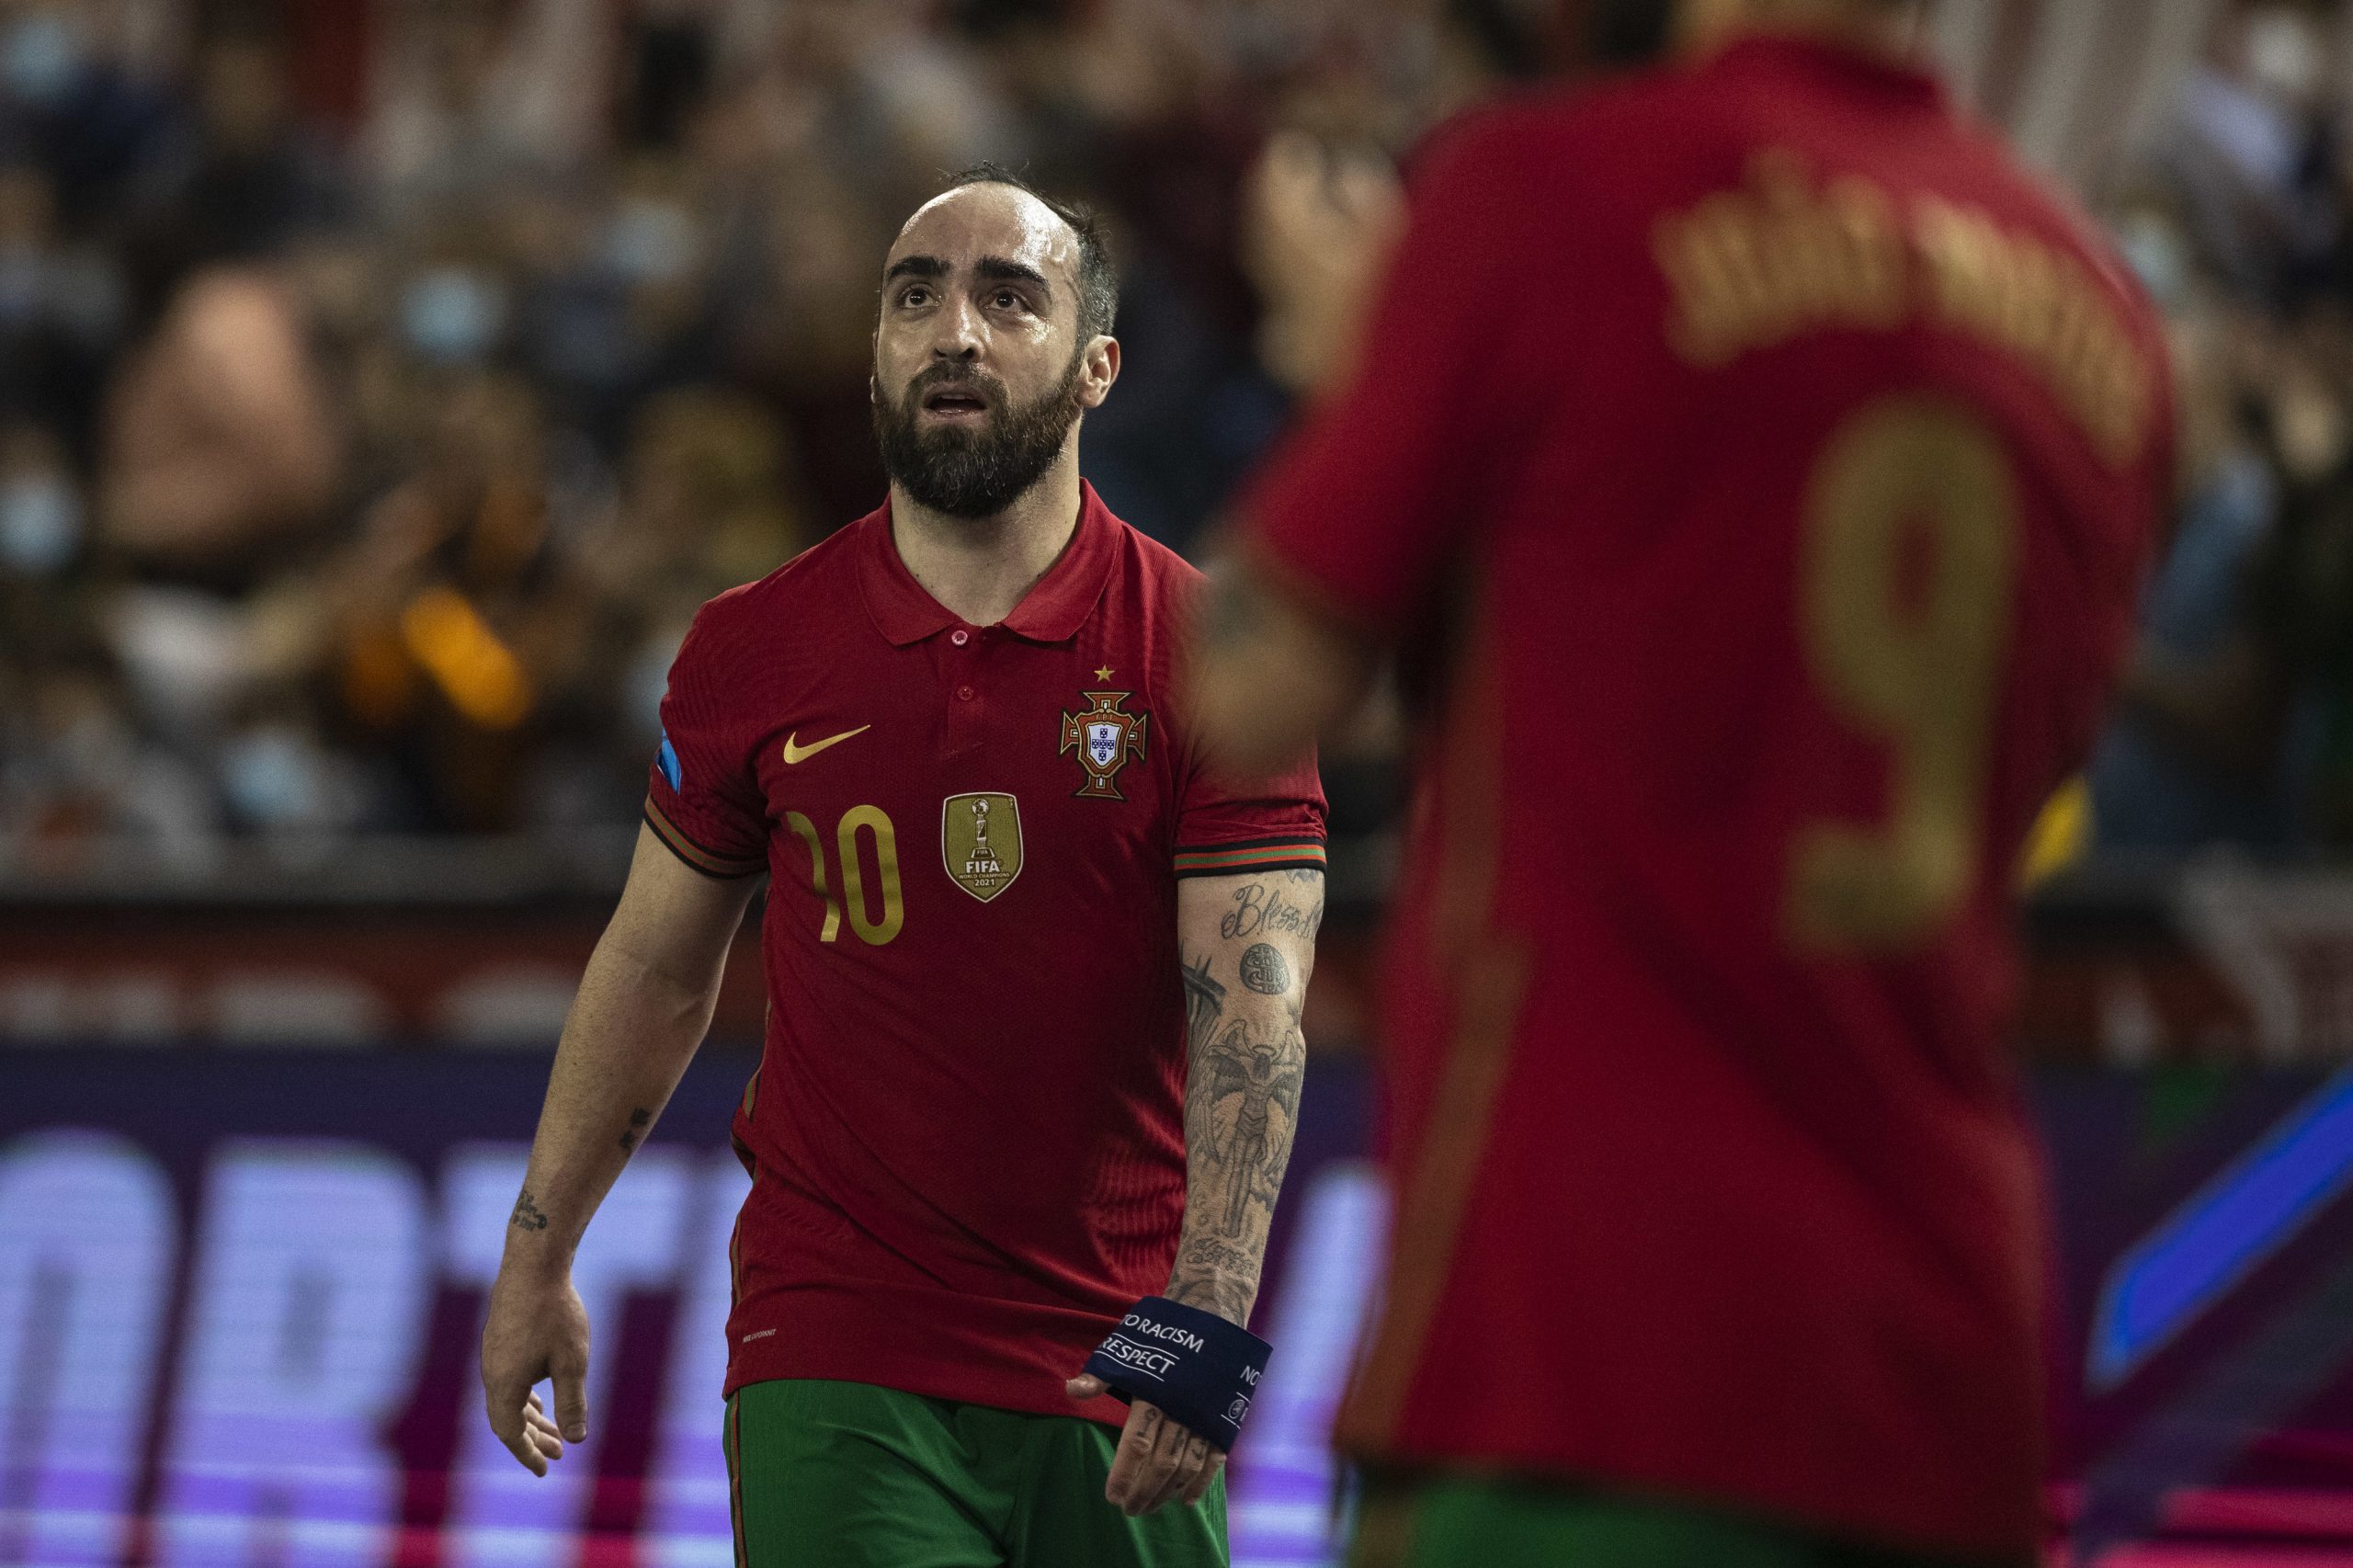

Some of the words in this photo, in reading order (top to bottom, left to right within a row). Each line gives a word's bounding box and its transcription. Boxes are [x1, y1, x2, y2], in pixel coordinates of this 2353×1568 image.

[1790, 393, 2016, 952] 9
[786, 804, 904, 946] 10
[965, 860, 1000, 874] FIFA
[1137, 1318, 1205, 1353] RACISM
[1240, 1365, 1260, 1386] NO
